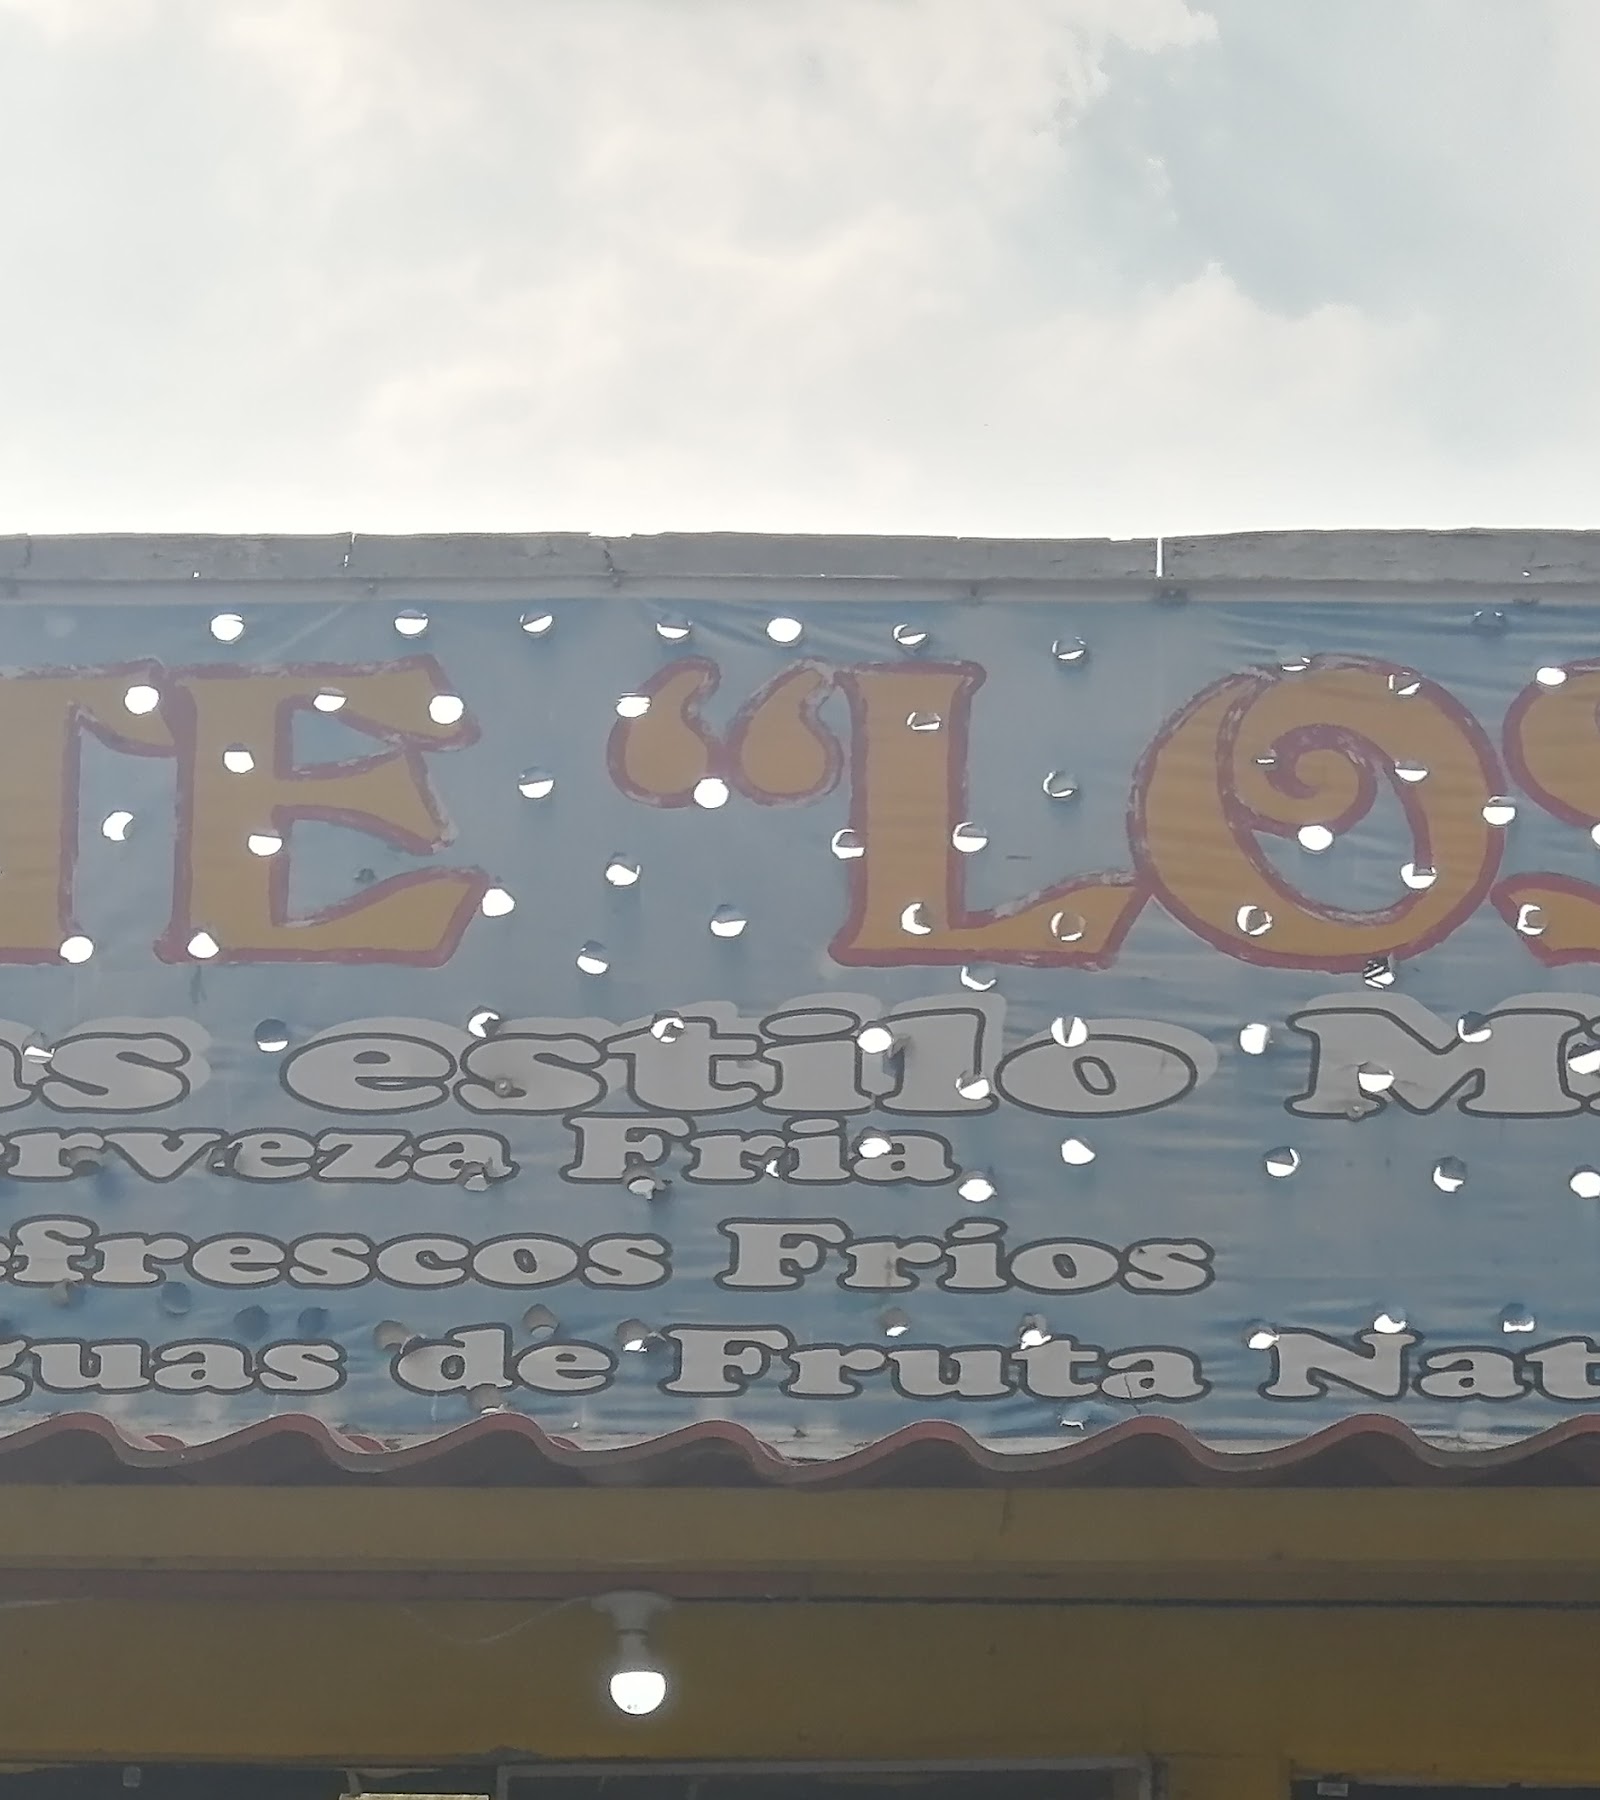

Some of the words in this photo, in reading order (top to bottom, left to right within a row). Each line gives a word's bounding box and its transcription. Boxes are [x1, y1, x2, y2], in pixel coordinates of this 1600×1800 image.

[280, 1000, 1210, 1118] estilo
[558, 1114, 962, 1186] Fria
[390, 1324, 618, 1396] de
[658, 1322, 1212, 1401] Fruta
